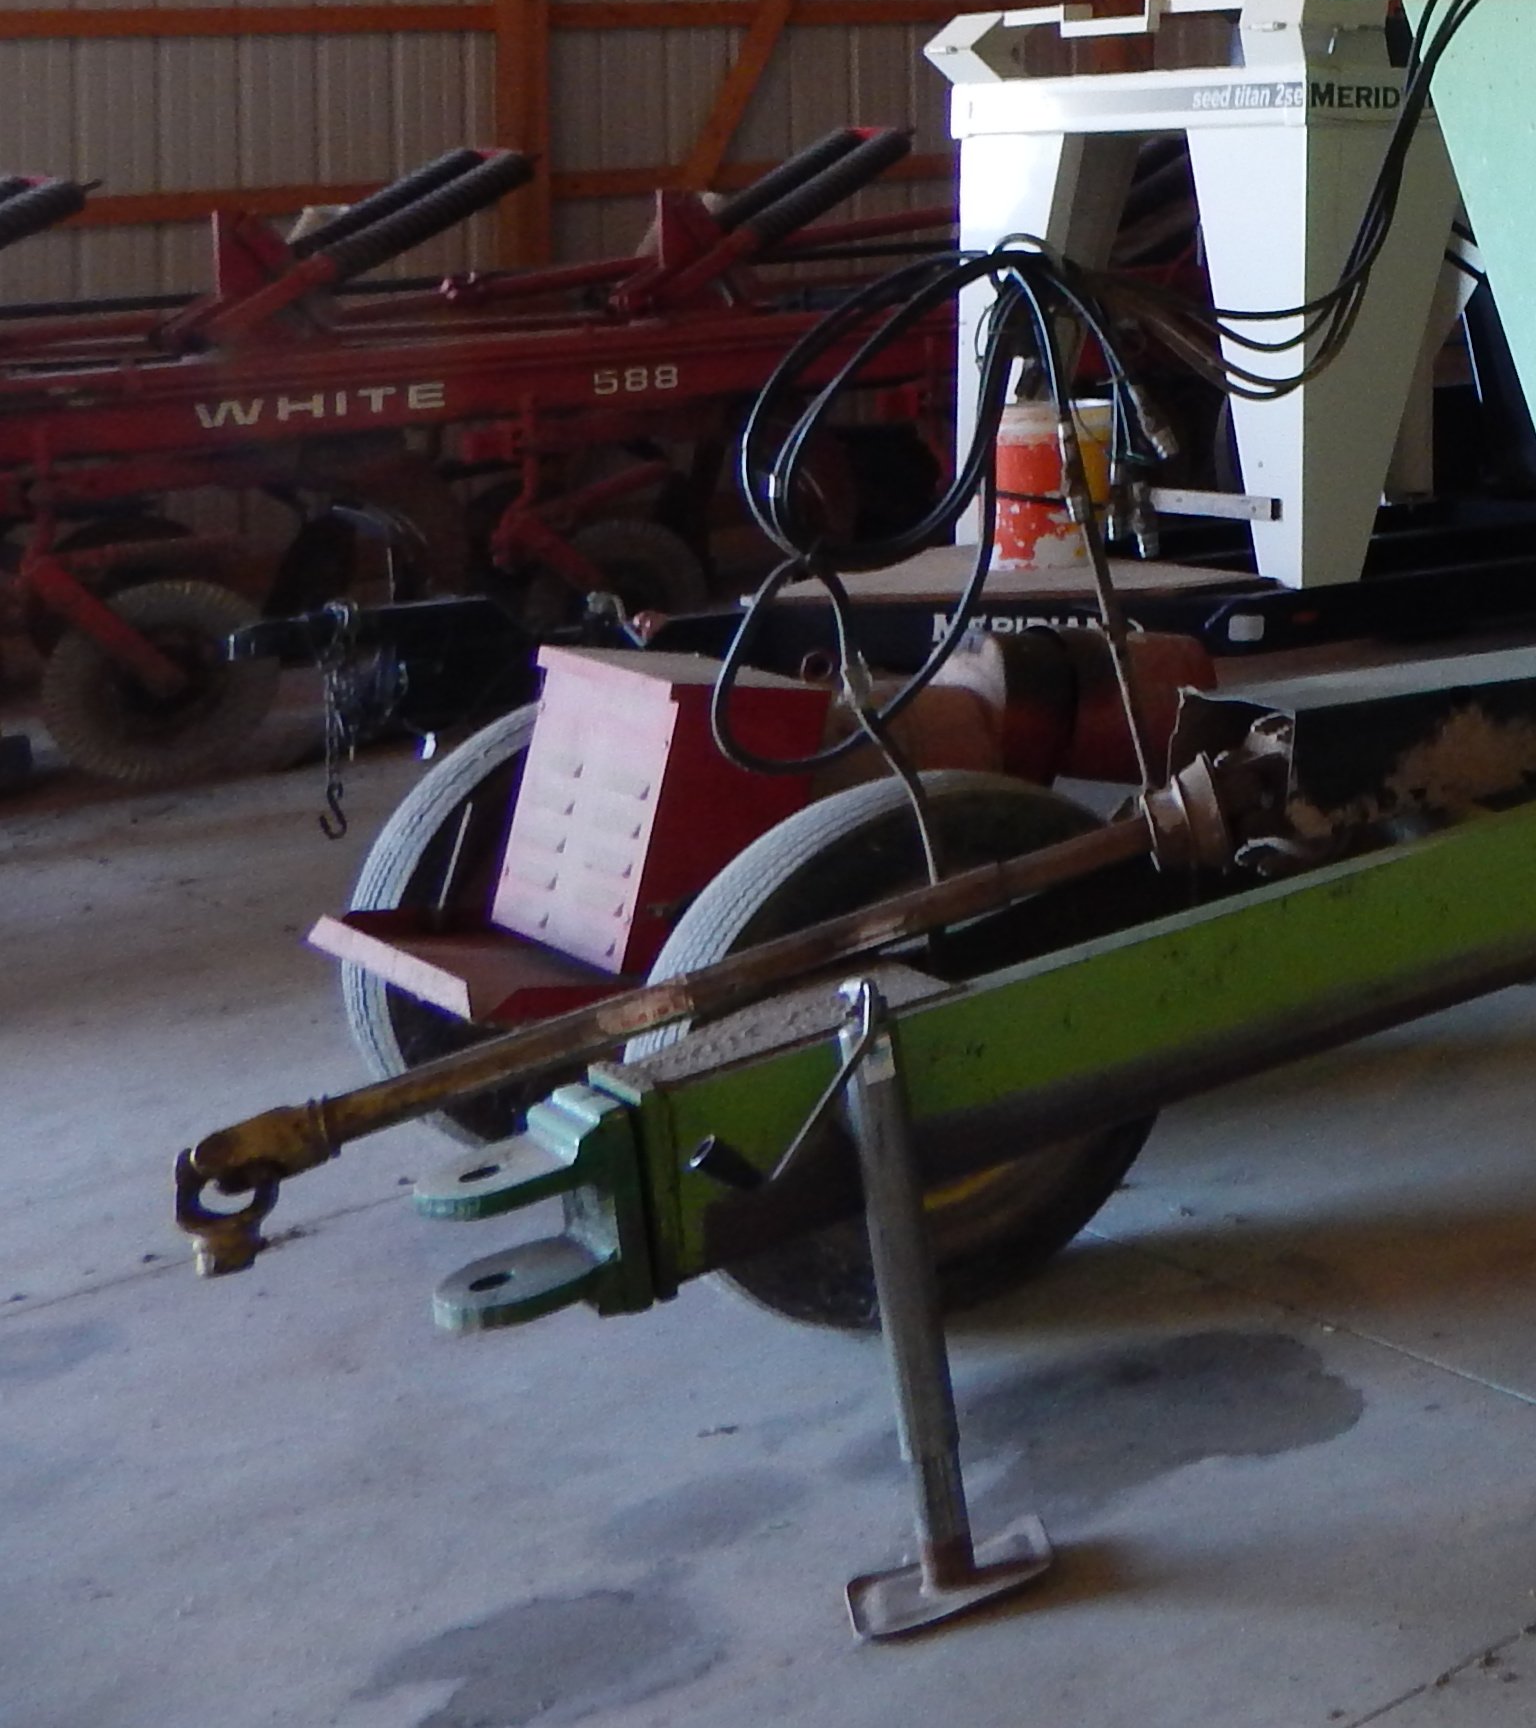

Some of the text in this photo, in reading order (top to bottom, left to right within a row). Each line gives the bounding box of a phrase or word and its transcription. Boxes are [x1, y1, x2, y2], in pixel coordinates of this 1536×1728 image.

[1192, 85, 1232, 109] seed
[1234, 84, 1271, 108] titan
[1310, 82, 1434, 109] MERID
[195, 365, 678, 429] WHITE 588
